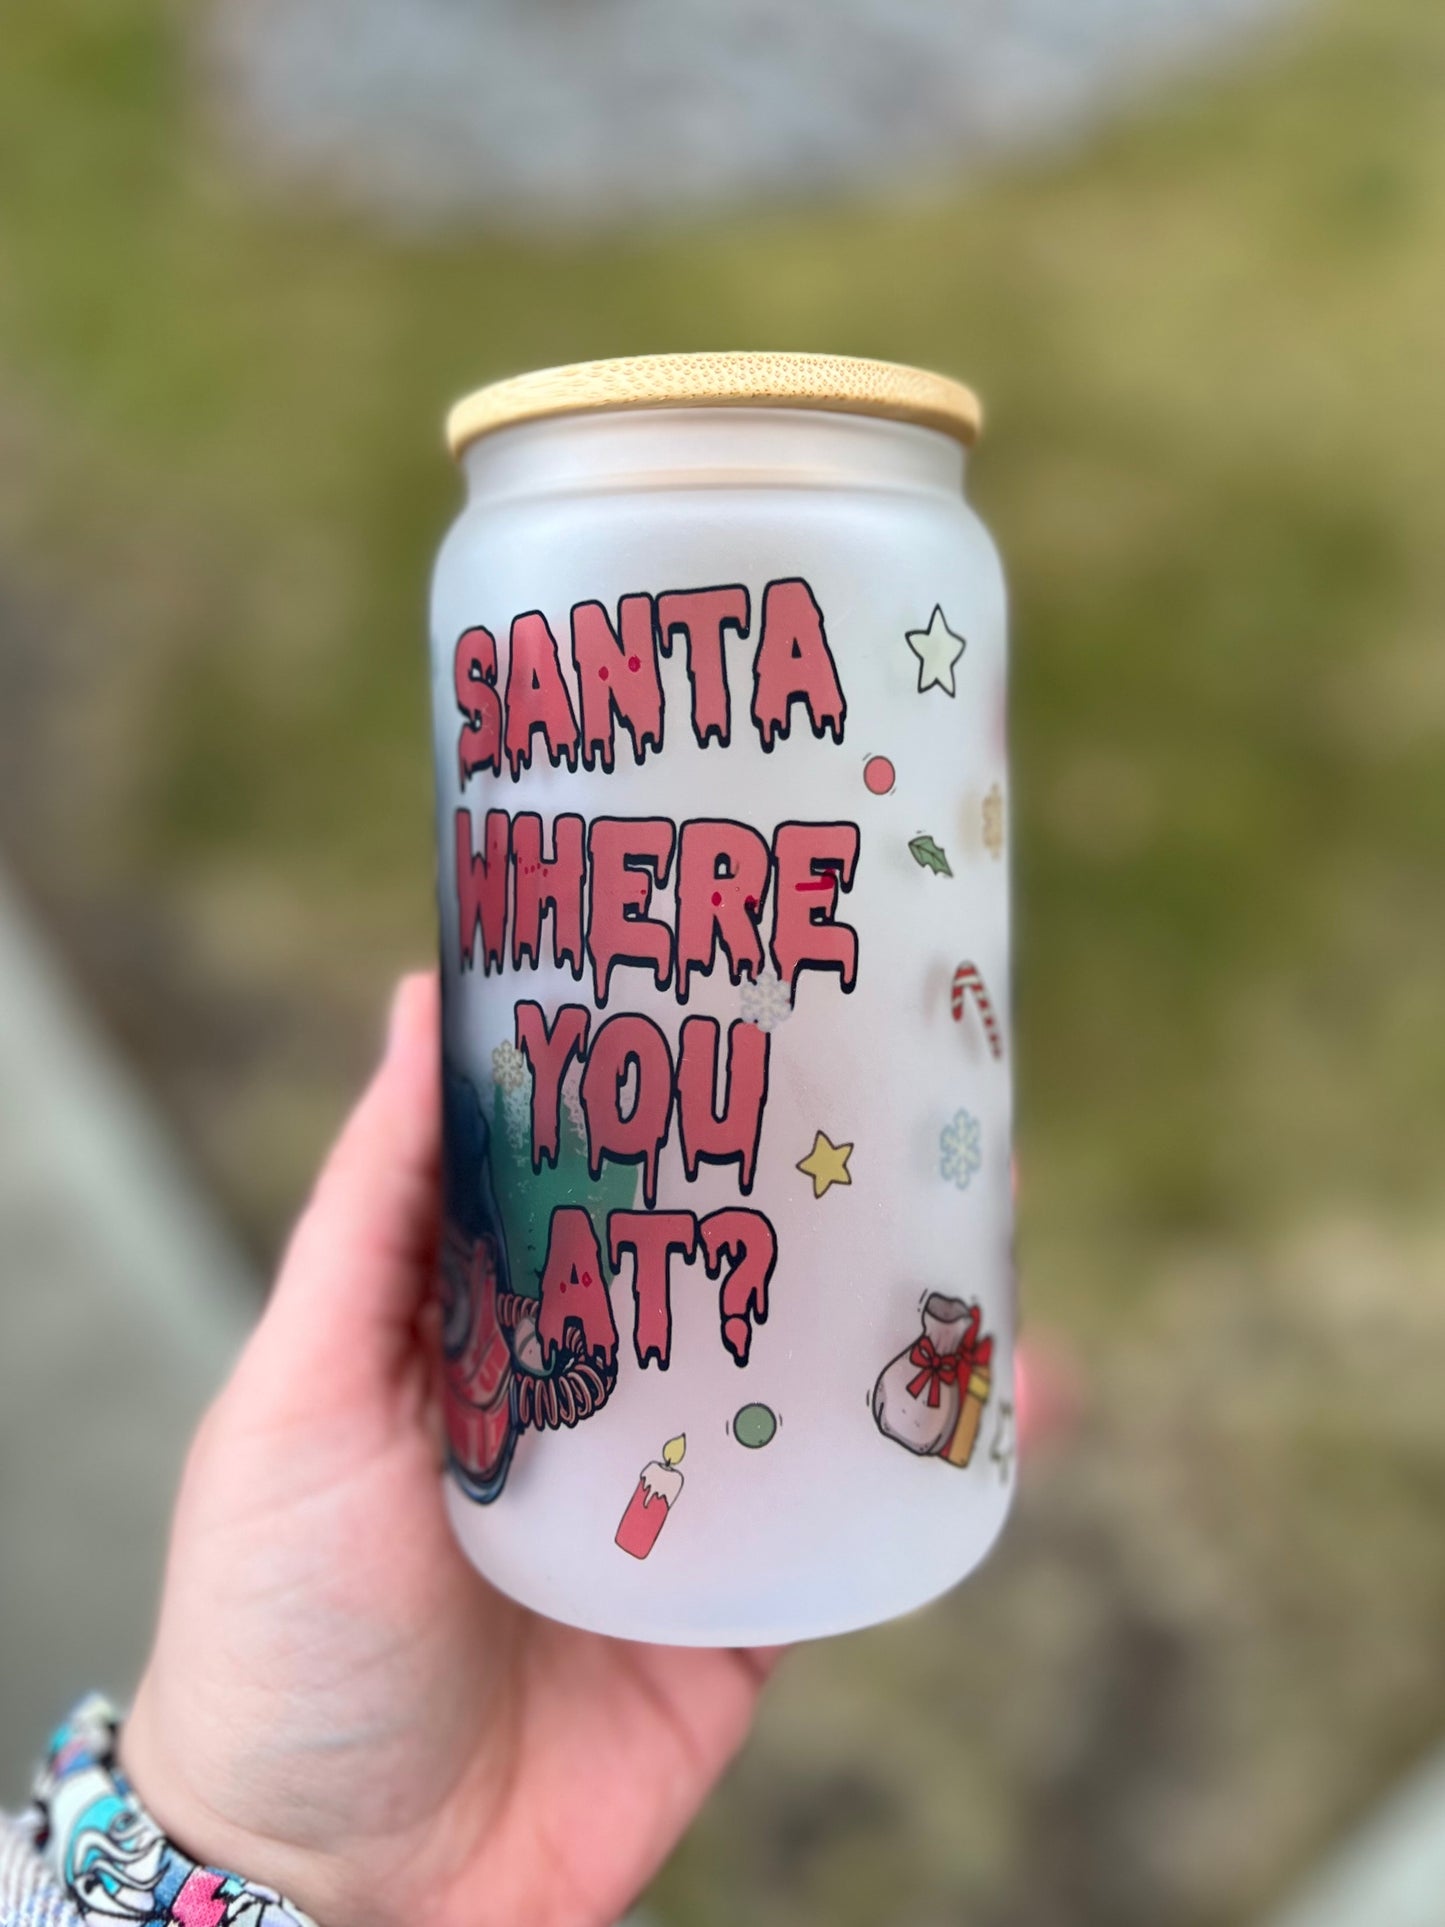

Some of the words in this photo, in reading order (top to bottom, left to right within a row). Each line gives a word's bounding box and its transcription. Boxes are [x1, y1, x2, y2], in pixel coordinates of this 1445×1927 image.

[454, 577, 847, 792] SANTA
[455, 808, 860, 1010] WHERE
[514, 1000, 771, 1209] YOU
[536, 1206, 777, 1371] AT?
